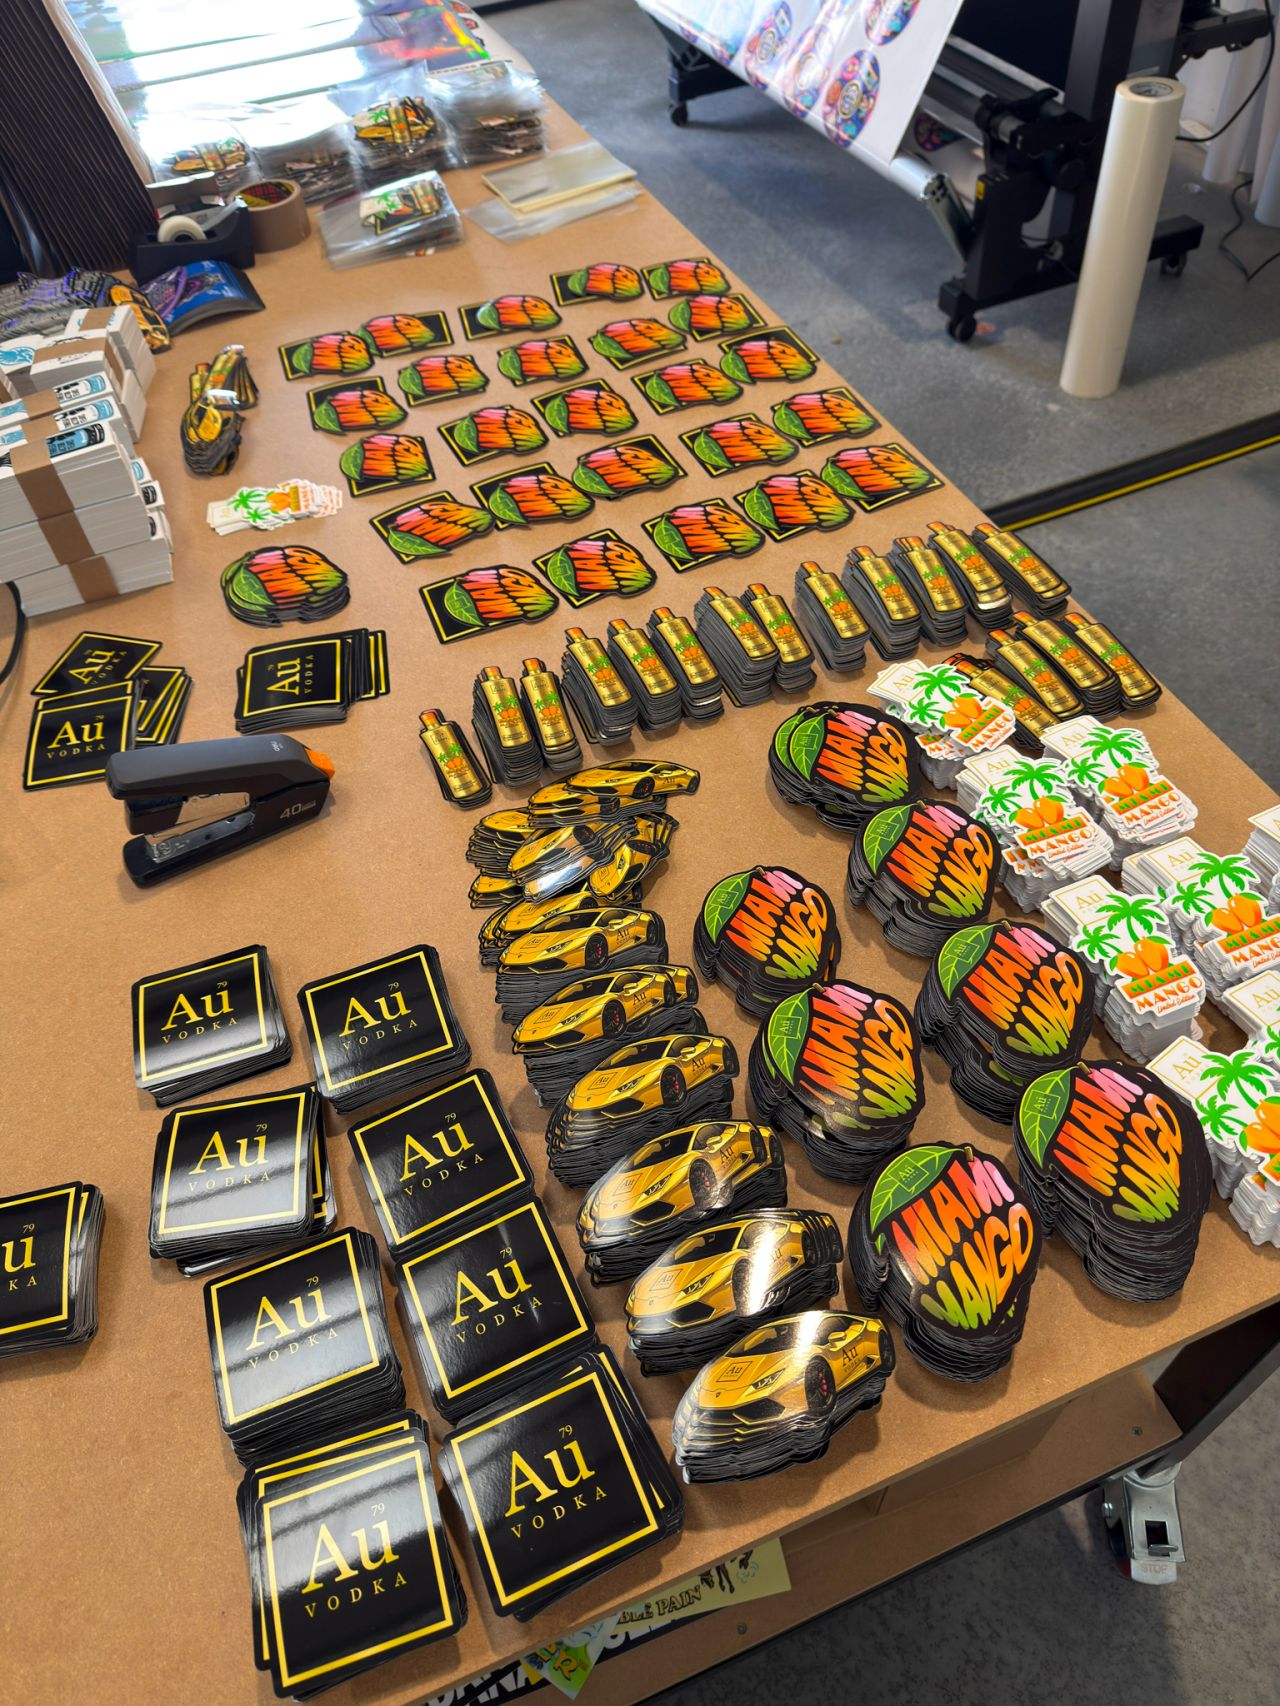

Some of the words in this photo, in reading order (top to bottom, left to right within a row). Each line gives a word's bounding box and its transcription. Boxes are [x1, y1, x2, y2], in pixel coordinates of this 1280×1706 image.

[68, 651, 115, 684] Au
[266, 657, 300, 695] Au
[304, 654, 314, 694] VODKA
[47, 743, 105, 759] VODKA
[48, 720, 105, 749] Au
[816, 710, 877, 791] MIAMI
[861, 721, 909, 803] MANGO
[986, 760, 1012, 774] Au
[279, 803, 303, 821] 40
[1119, 783, 1169, 811] MIAMI
[1124, 792, 1181, 825] MANGO
[1025, 819, 1082, 841] MIAMI
[1029, 828, 1093, 856] MANGO
[886, 805, 968, 898] MIAMI
[1167, 851, 1195, 867] Au
[928, 824, 994, 918] MANGO
[725, 870, 804, 961] MIAMI
[1076, 893, 1103, 910] Au
[765, 887, 828, 979] MANGO
[217, 981, 228, 989] 79
[388, 982, 399, 991] 79
[963, 927, 1056, 1030] MIAMI
[1130, 965, 1191, 994] MIAMI
[1136, 977, 1203, 1011] MANGO
[161, 990, 234, 1031] Au
[339, 991, 412, 1038] Au
[1006, 951, 1083, 1057] MANGO
[162, 1018, 237, 1044] VODKA
[343, 1019, 418, 1050] VODKA
[801, 984, 873, 1100] MIAMI
[859, 999, 918, 1119] MANGO
[1172, 1056, 1202, 1080] Au
[256, 1123, 268, 1133] 79
[445, 1112, 456, 1122] 79
[1053, 1068, 1144, 1197] MIAMI
[188, 1131, 270, 1175] Au
[400, 1122, 475, 1182] Au
[1112, 1093, 1183, 1223] MANGO
[188, 1171, 272, 1191] VODKA
[404, 1154, 484, 1196] VODKA
[23, 1223, 35, 1233] 79
[891, 1156, 1015, 1286] MIAMI
[0, 1236, 36, 1273] u
[500, 1247, 512, 1259] 79
[920, 1202, 1034, 1330] MANGO
[306, 1275, 319, 1287] 79
[451, 1259, 533, 1326] Au
[246, 1288, 332, 1351] Au
[456, 1297, 542, 1343] VODKA
[249, 1328, 339, 1369] VODKA
[842, 1345, 858, 1367] Au
[558, 1425, 573, 1438] 79
[504, 1440, 596, 1518] Au
[371, 1503, 385, 1516] 79
[511, 1487, 607, 1539] VODKA
[301, 1520, 400, 1594] Au
[305, 1572, 407, 1618] VODKA
